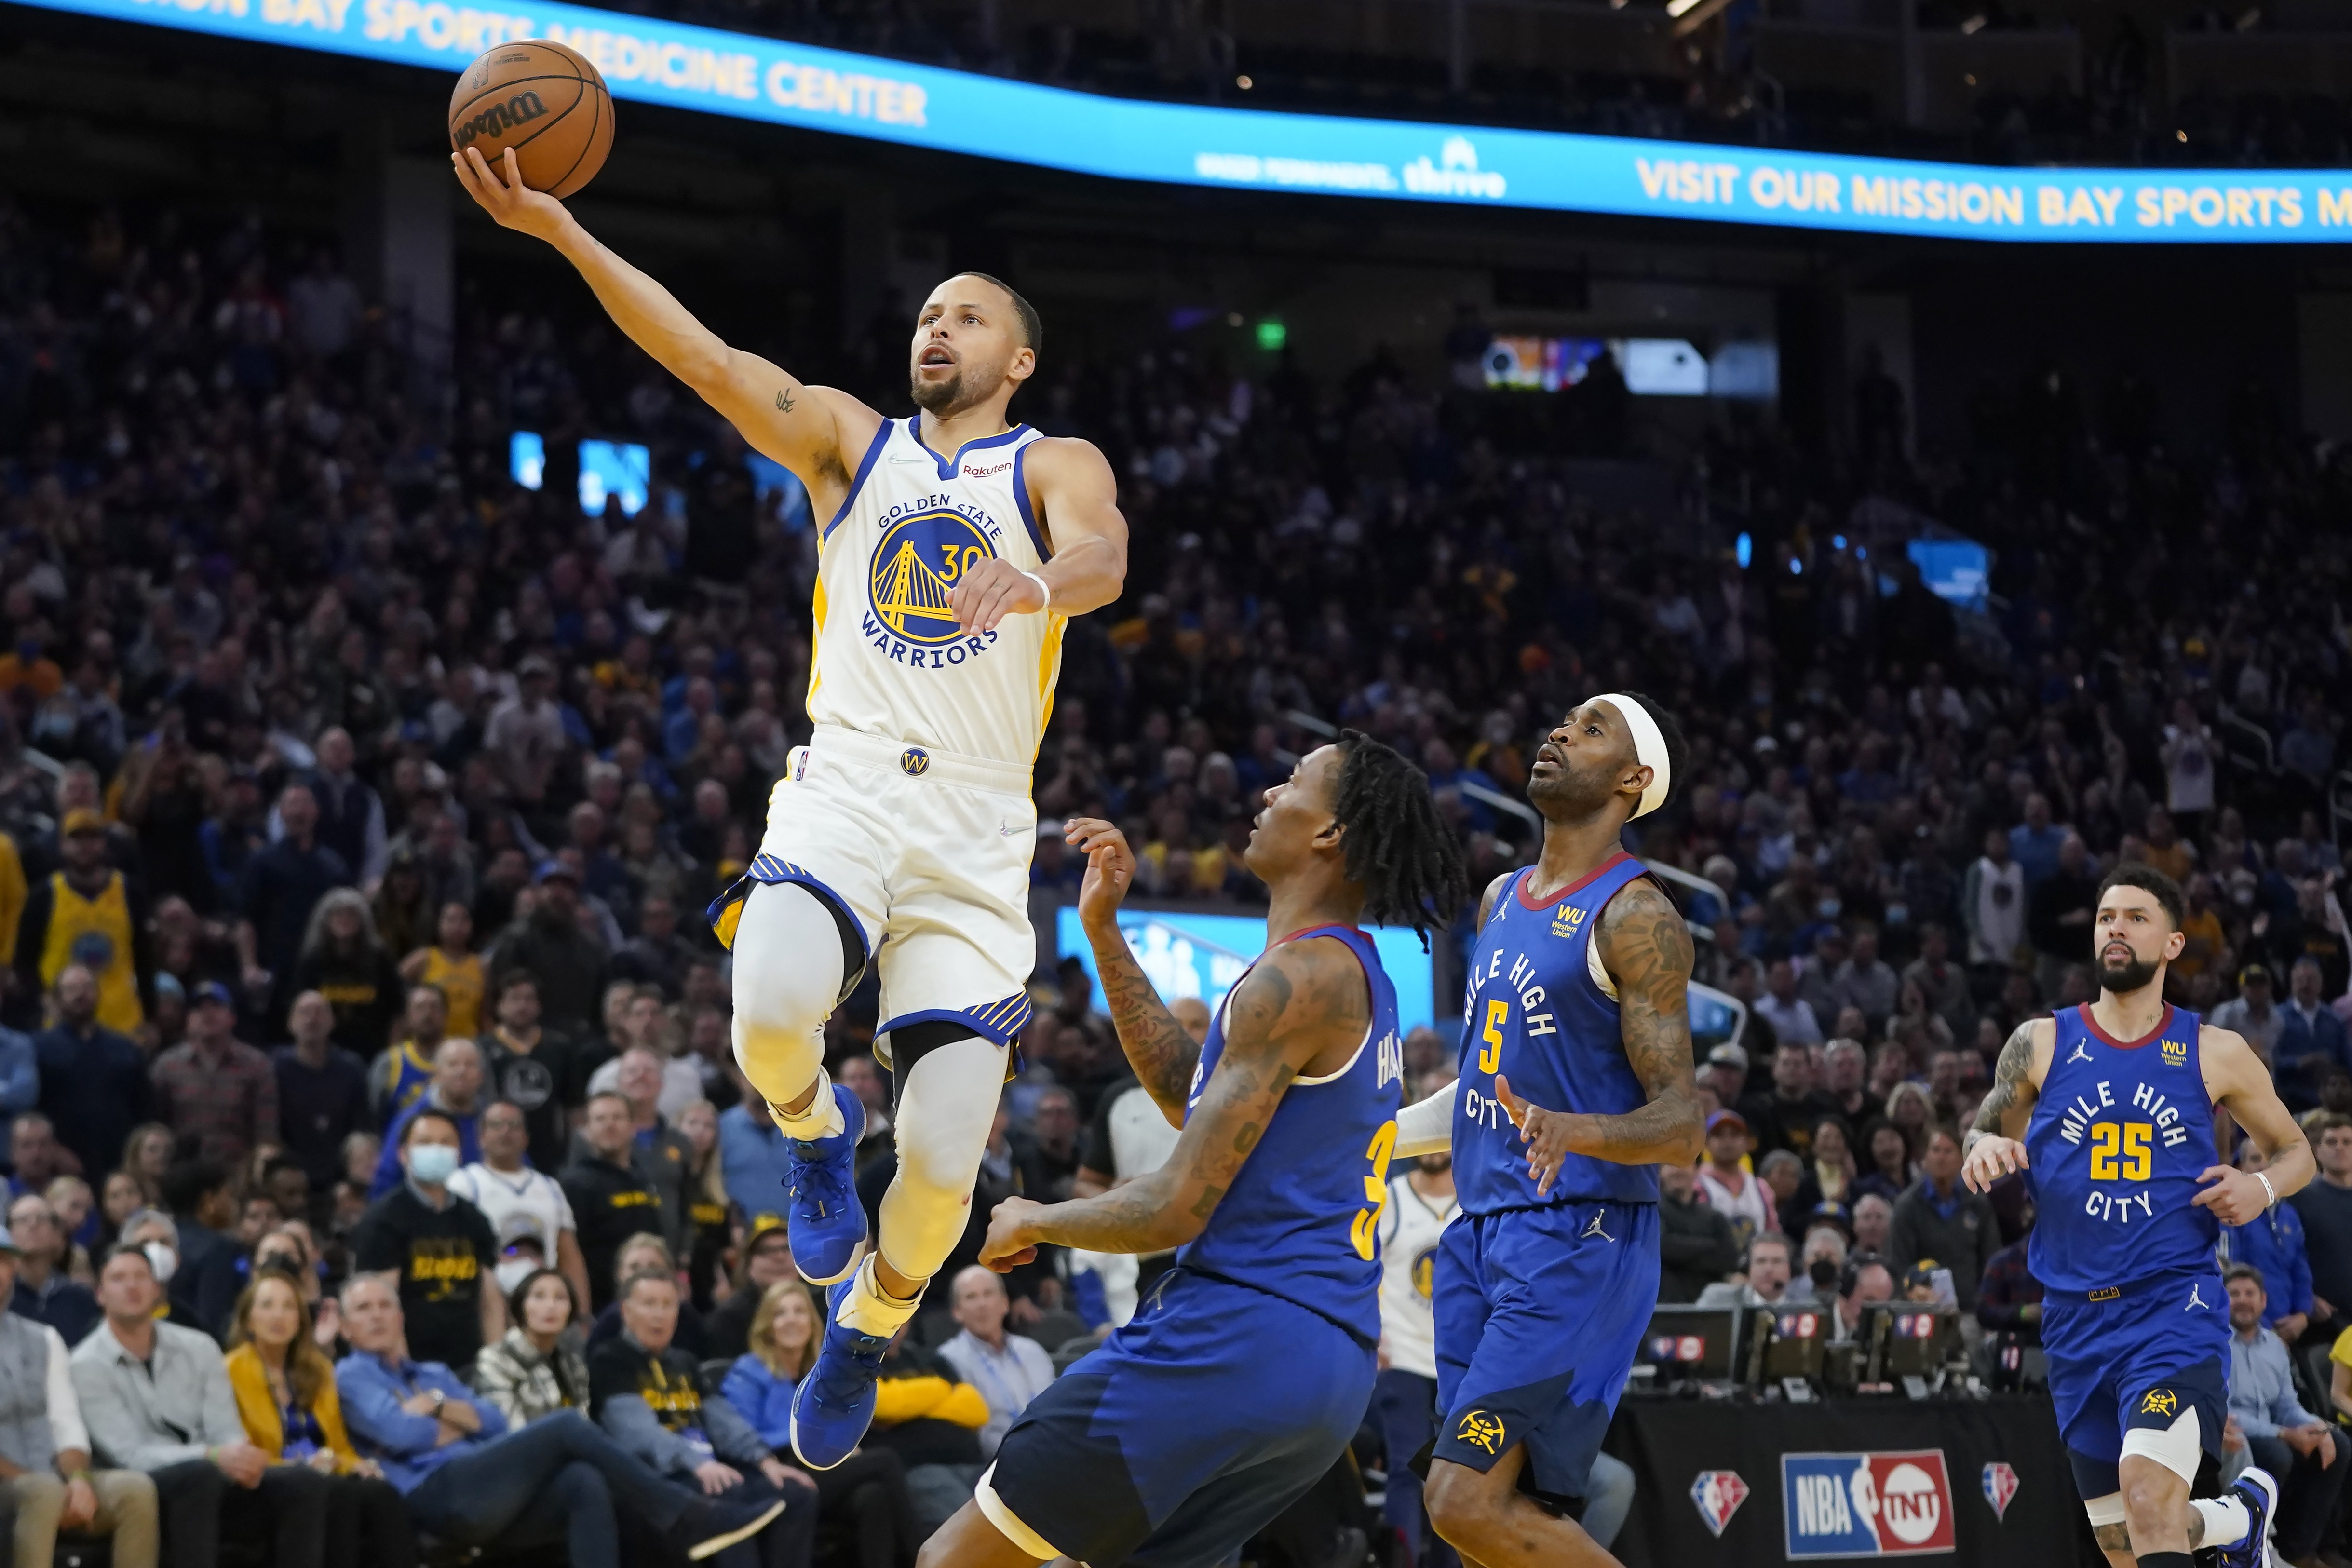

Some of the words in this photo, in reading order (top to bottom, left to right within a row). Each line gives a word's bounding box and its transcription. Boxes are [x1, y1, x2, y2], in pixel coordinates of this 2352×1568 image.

[363, 0, 534, 57] SPORTS
[766, 61, 928, 127] CENTER
[453, 90, 549, 149] Wilson
[1636, 158, 1740, 205] VISIT
[1749, 166, 1842, 214] OUR
[1851, 174, 2024, 225] MISSION
[2038, 186, 2123, 226] BAY
[2135, 187, 2303, 227] SPORTS
[963, 463, 1012, 475] Rakuten
[879, 494, 951, 528] GOLDEN
[957, 504, 1002, 540] STATE
[862, 609, 998, 669] WARRIORS
[905, 752, 928, 773] W
[1552, 920, 1577, 933] Western
[1552, 928, 1570, 939] Union
[1557, 904, 1587, 924] WU
[1464, 948, 1504, 1026] MILE
[1509, 953, 1556, 1037] HIGH
[1479, 999, 1509, 1074] 5
[2161, 1039, 2186, 1055] WU
[2161, 1052, 2187, 1062] Western
[2061, 1081, 2115, 1145] MILE
[2132, 1082, 2187, 1147] HIGH
[2090, 1122, 2152, 1181] 25
[2085, 1190, 2153, 1223] CITY
[1796, 1475, 1853, 1536] NBA
[1883, 1491, 1938, 1521] TNT
